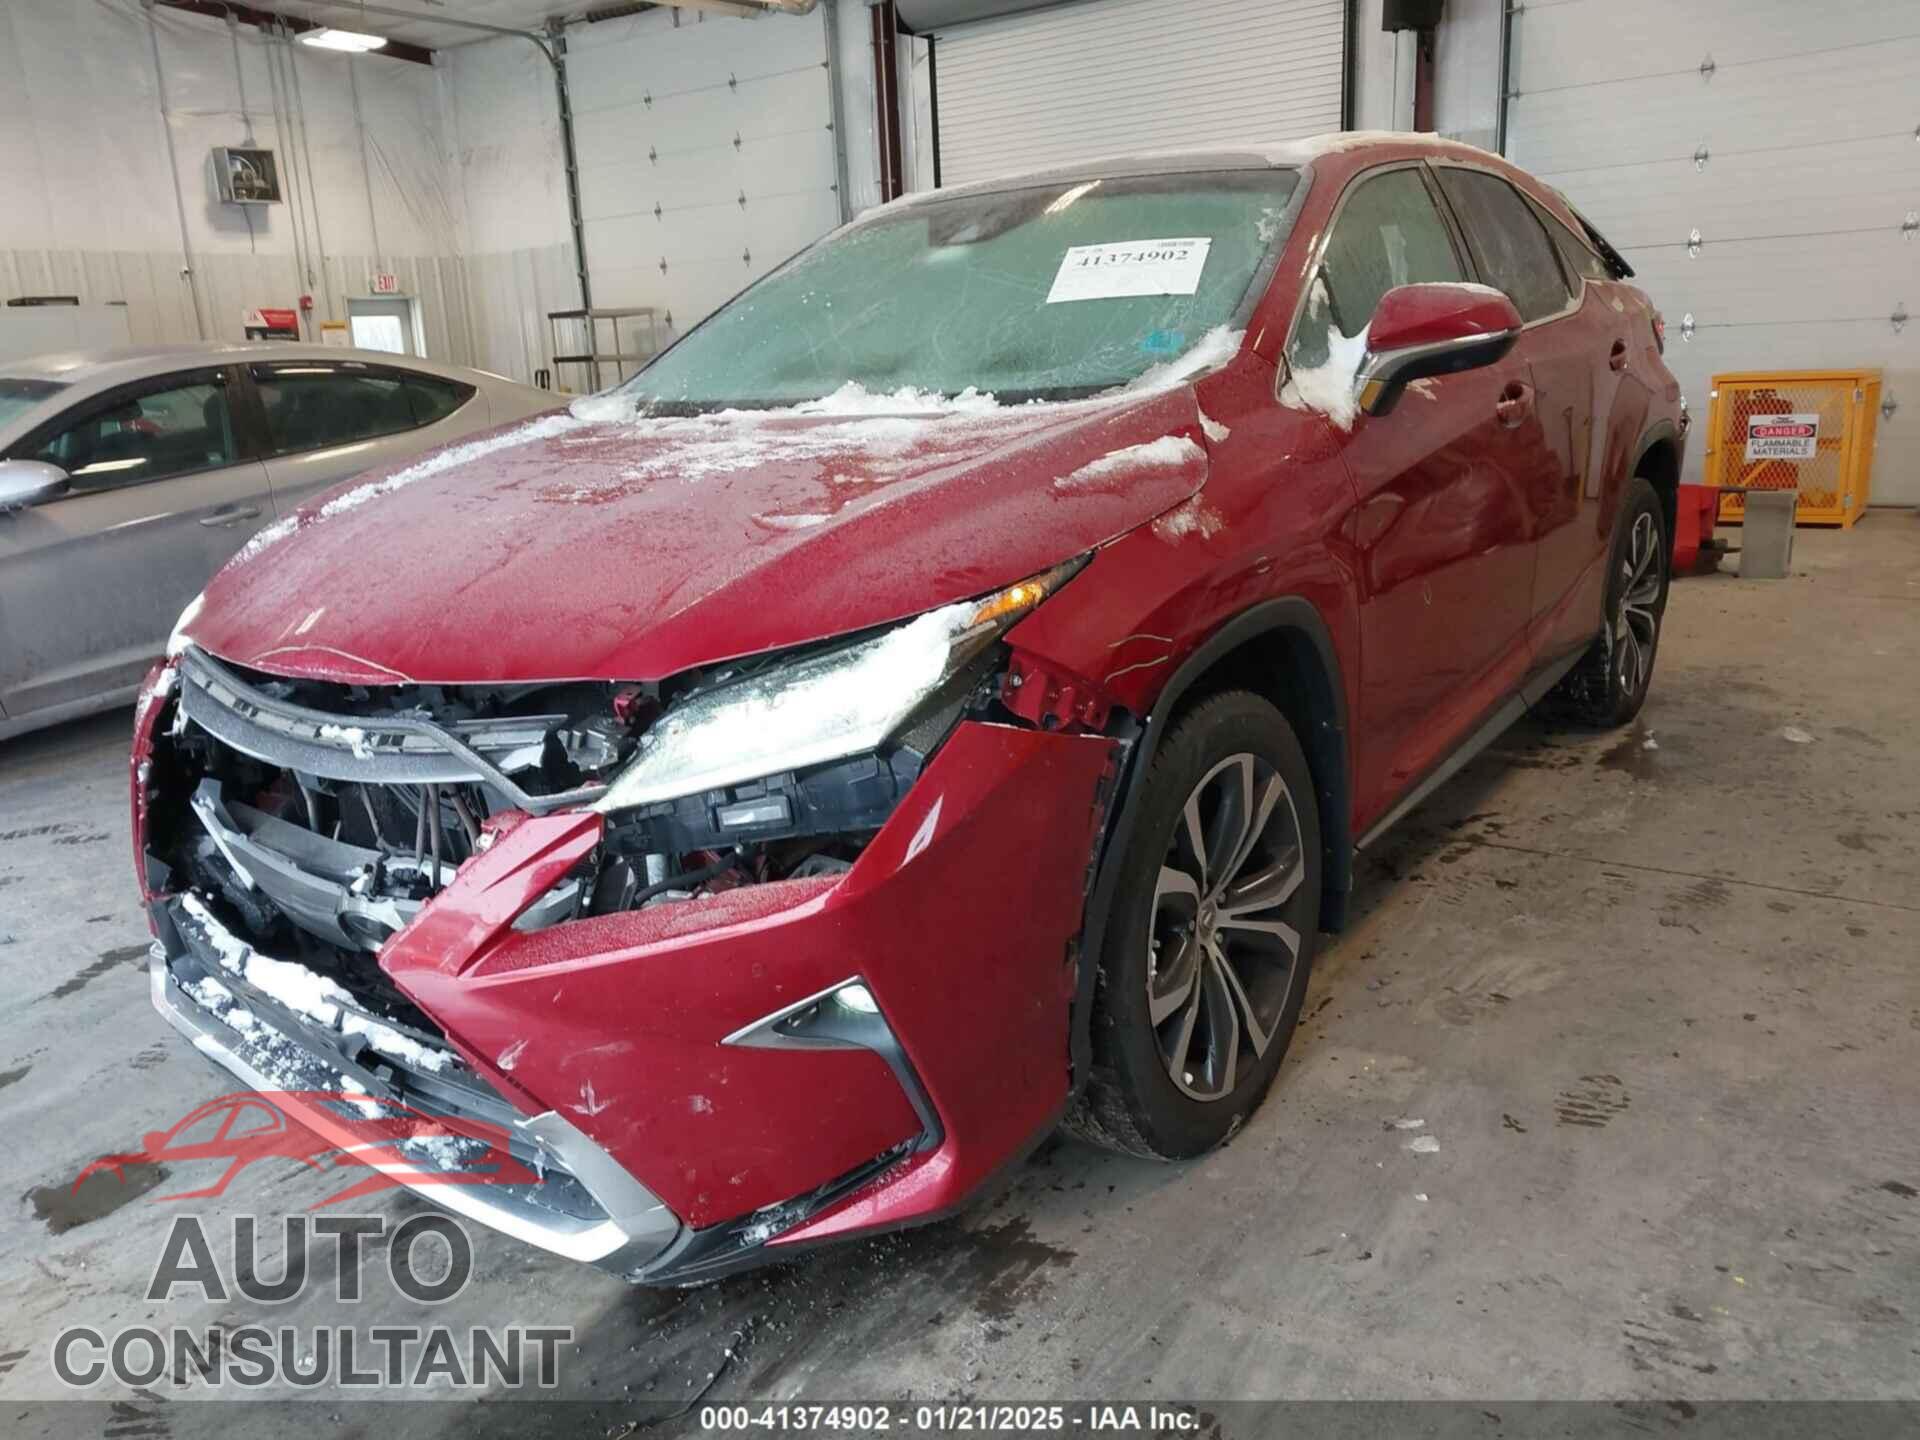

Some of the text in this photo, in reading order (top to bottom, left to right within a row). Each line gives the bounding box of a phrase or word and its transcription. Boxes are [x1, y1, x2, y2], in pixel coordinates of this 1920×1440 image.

[1076, 248, 1189, 267] 41374902
[377, 275, 395, 290] EXIT
[1759, 426, 1807, 437] DANGER
[1751, 438, 1810, 447] FLAMMABLE
[1752, 447, 1809, 456] MATERIALS
